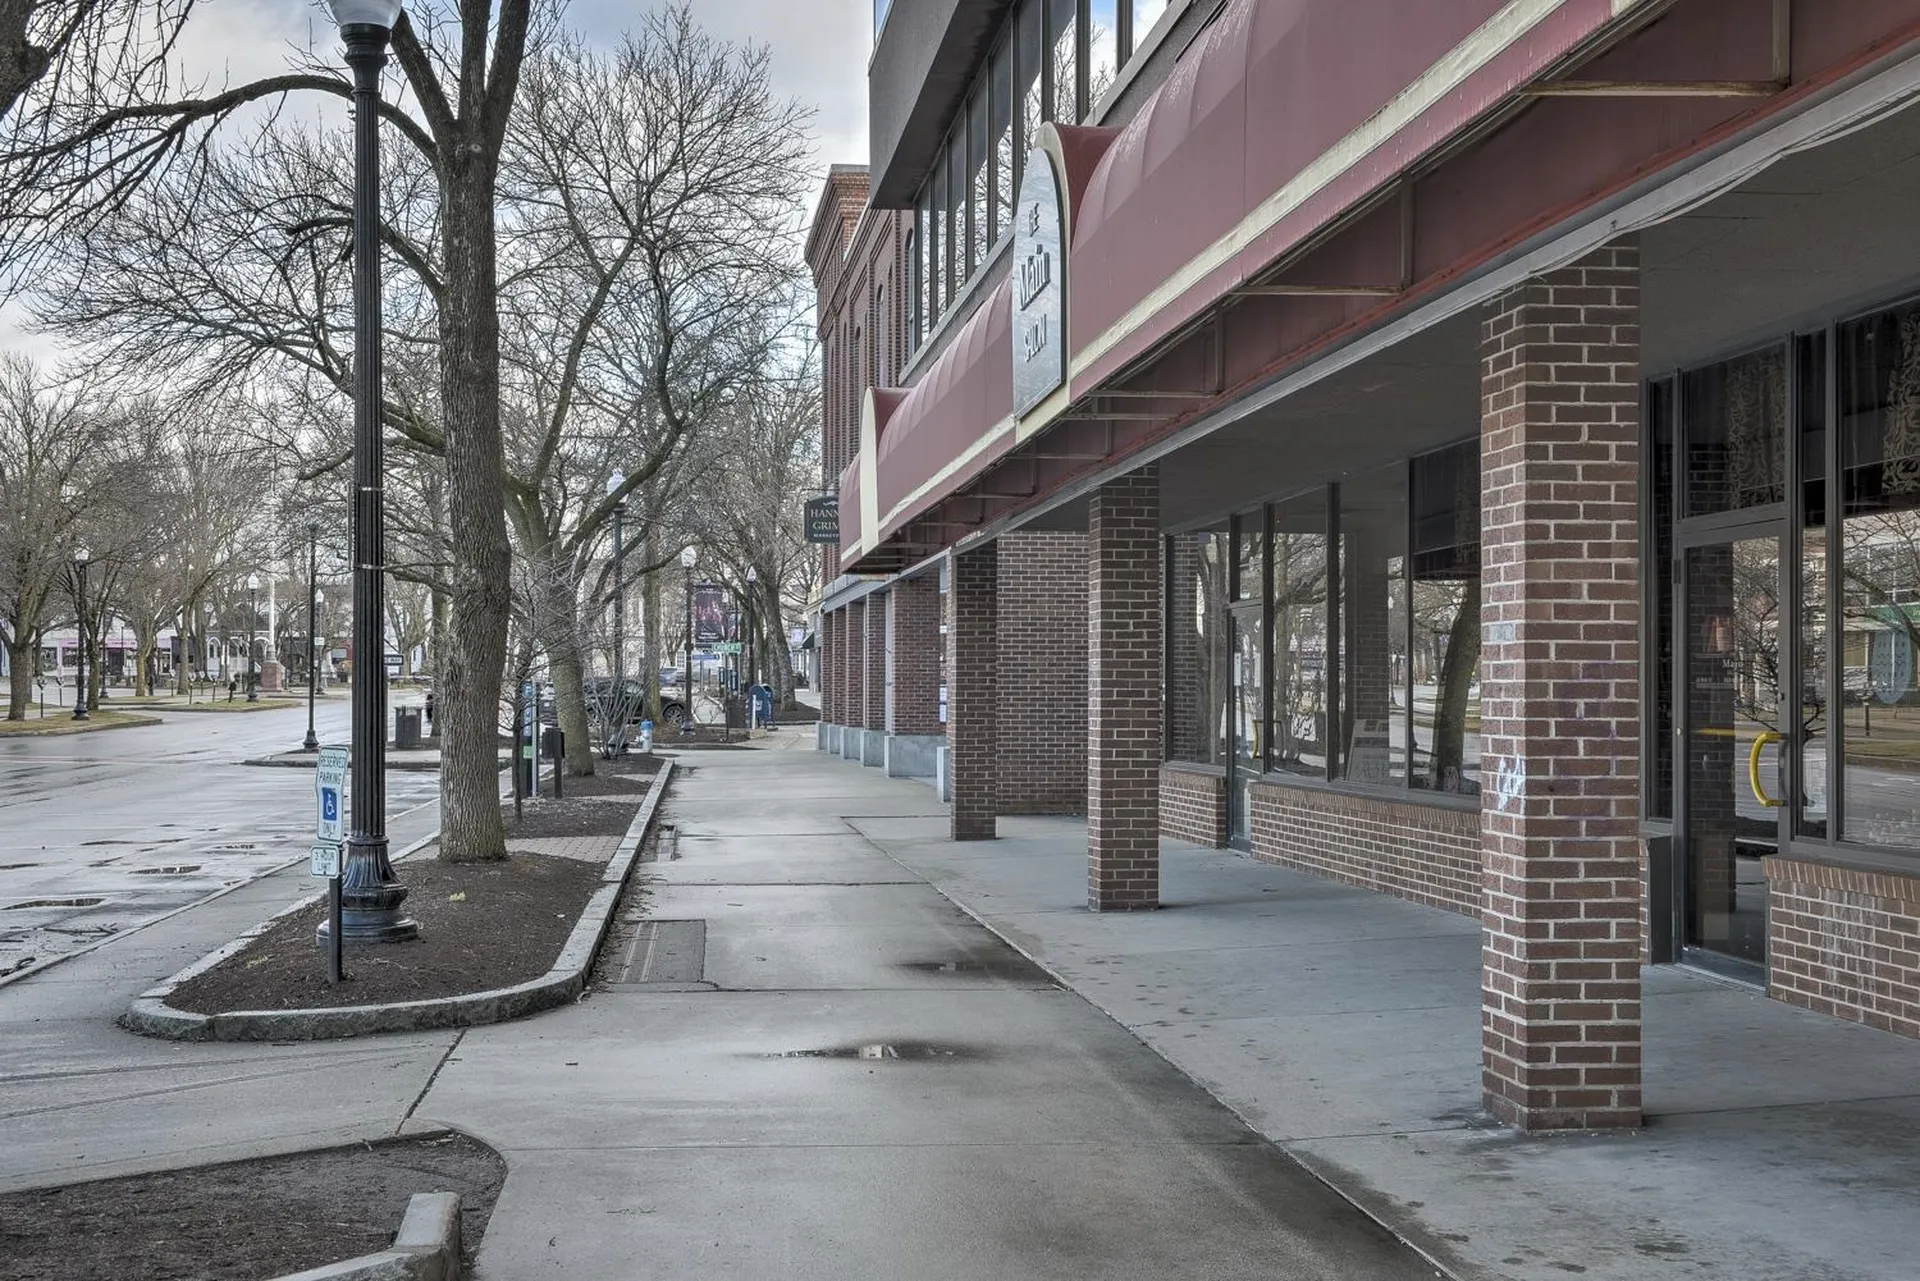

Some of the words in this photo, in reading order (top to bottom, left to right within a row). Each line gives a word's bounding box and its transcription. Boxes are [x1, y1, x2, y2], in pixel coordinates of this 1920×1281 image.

[1020, 243, 1050, 311] Main
[320, 754, 346, 769] RESERVED
[319, 770, 342, 785] PARKING
[322, 821, 337, 835] ONLY
